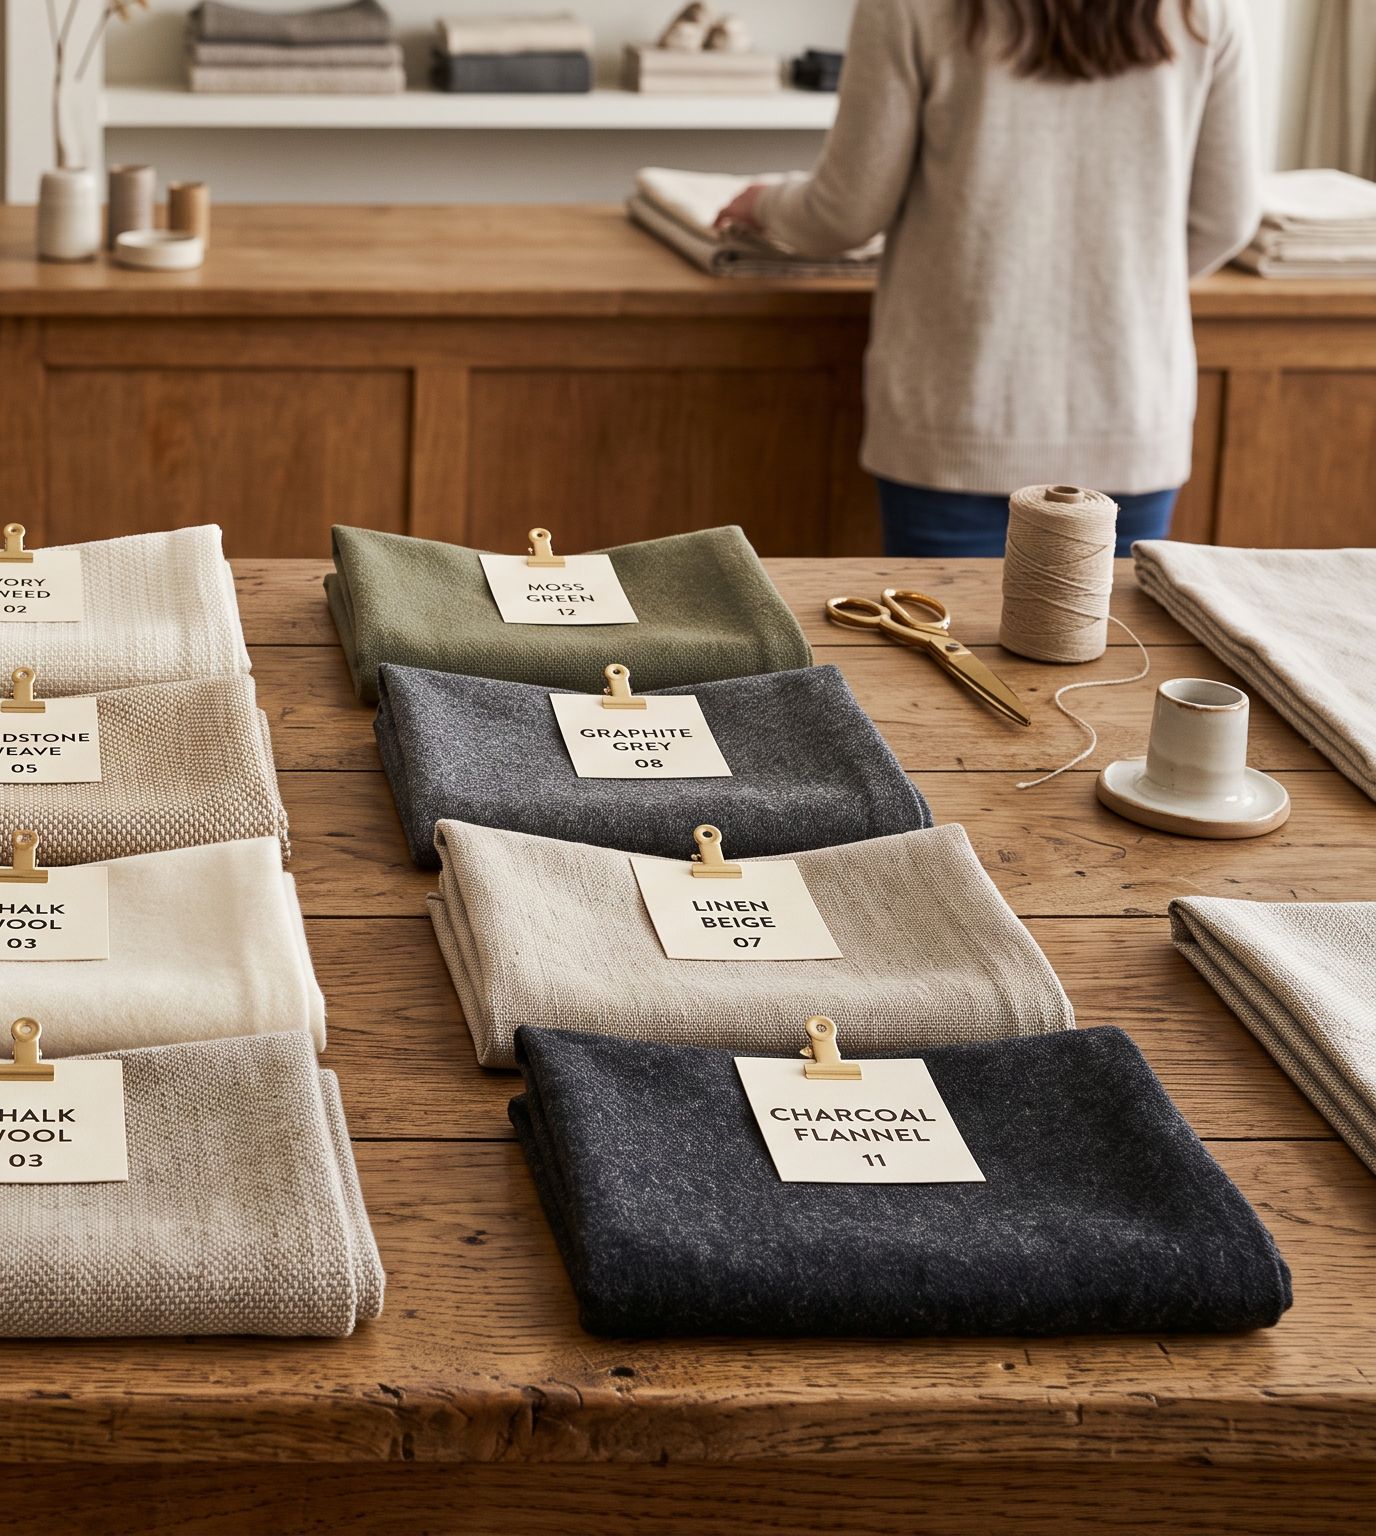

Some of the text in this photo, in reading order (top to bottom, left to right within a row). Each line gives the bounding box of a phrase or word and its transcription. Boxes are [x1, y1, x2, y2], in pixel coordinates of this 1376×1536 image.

[528, 583, 585, 592] MOSS
[526, 594, 595, 603] GREEN
[3, 604, 27, 614] 02
[556, 607, 577, 616] 12
[579, 728, 694, 739] GRAPHITE
[612, 741, 672, 752] GREY
[10, 763, 38, 774] 05
[634, 758, 664, 769] 08
[691, 900, 770, 913] LINEN
[700, 916, 777, 929] BEIGE
[6, 937, 37, 950] 03
[732, 936, 762, 948] 07
[769, 1107, 937, 1123] CHARCOAL
[793, 1127, 931, 1142] FLANNEL
[8, 1153, 44, 1168] 03
[861, 1153, 887, 1167] 11
